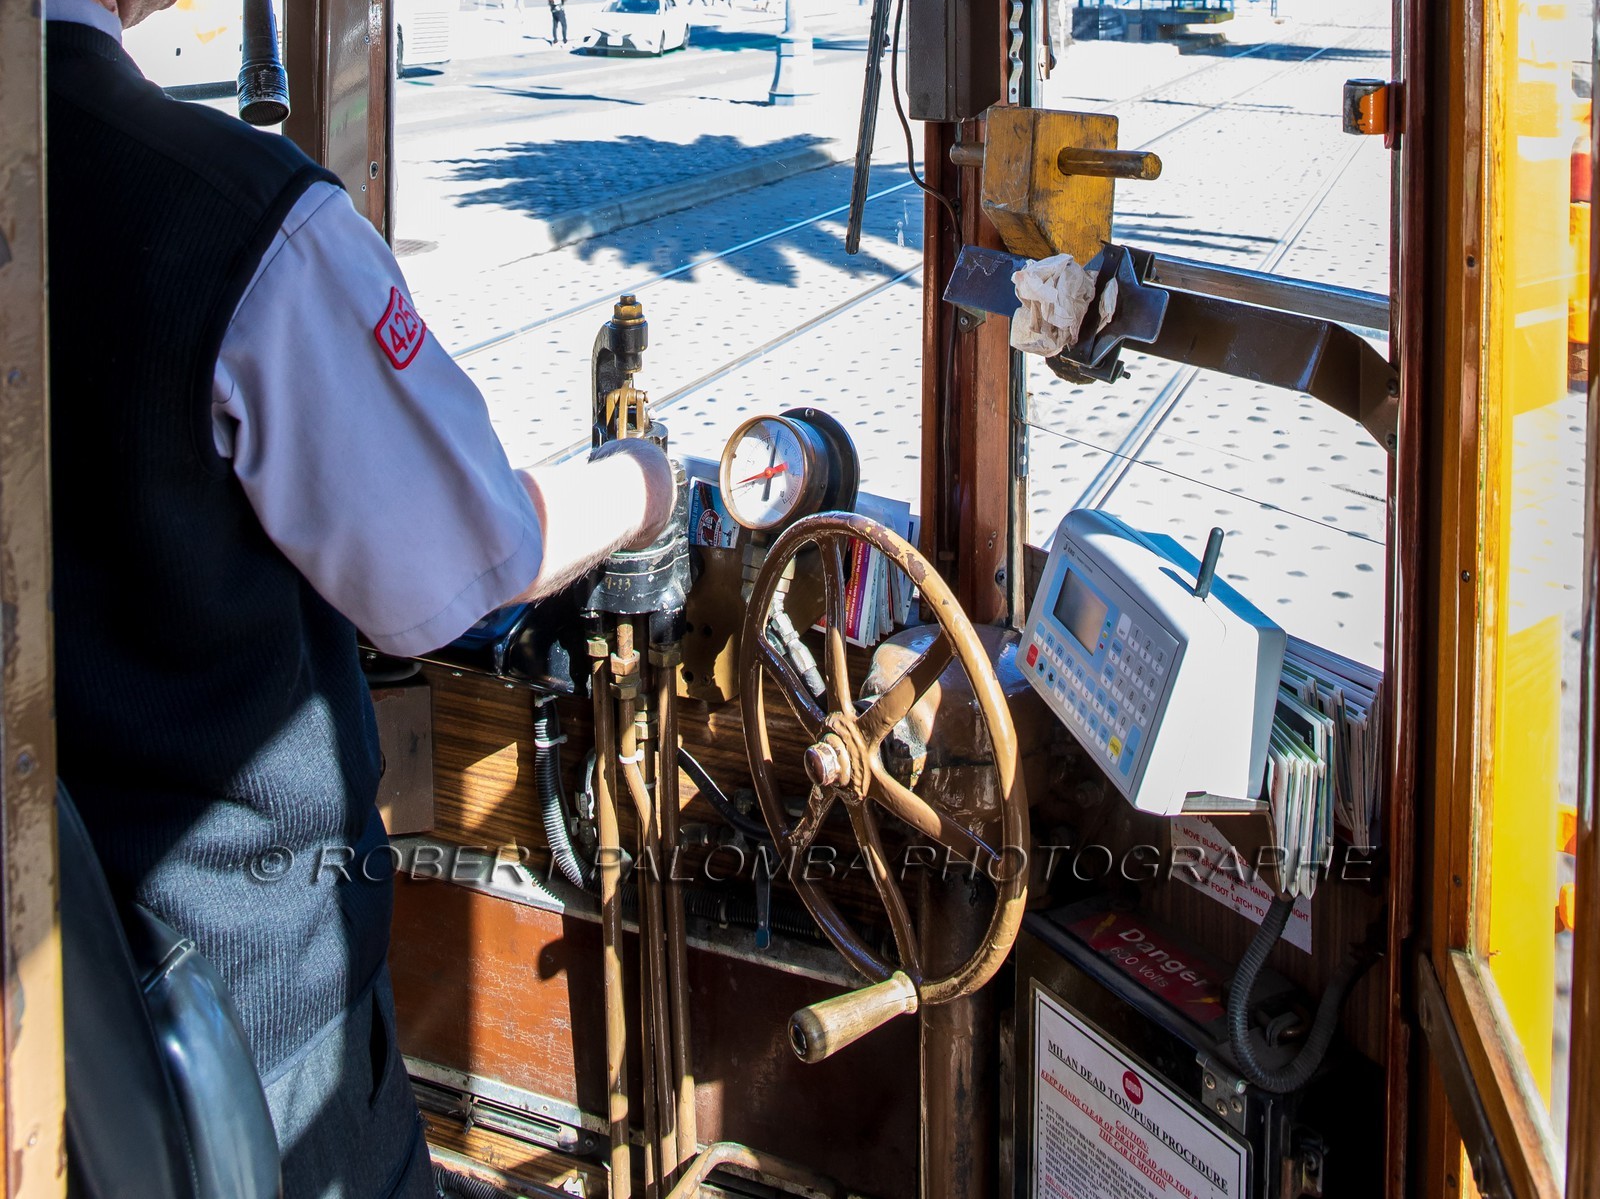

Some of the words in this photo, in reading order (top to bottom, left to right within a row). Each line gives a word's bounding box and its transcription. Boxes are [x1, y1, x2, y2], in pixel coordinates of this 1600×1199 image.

[1183, 828, 1200, 842] MOVE
[1202, 837, 1222, 852] BLACK
[1211, 881, 1229, 898] FOOT
[1231, 891, 1253, 911] LATCH
[1255, 905, 1265, 917] TO
[1110, 946, 1139, 966] 600
[1138, 964, 1169, 988] Volts
[1118, 927, 1210, 988] Danger
[1041, 1069, 1057, 1088] KEEP
[1048, 1040, 1077, 1072] MILAN
[1080, 1066, 1105, 1094] DEAD
[1109, 1088, 1158, 1137] TOW/PUSH
[1162, 1133, 1227, 1193] PROCEDURE
[1116, 1119, 1148, 1152] CAUTION:
[1114, 1140, 1127, 1158] CAR
[1138, 1160, 1165, 1190] MOTION
